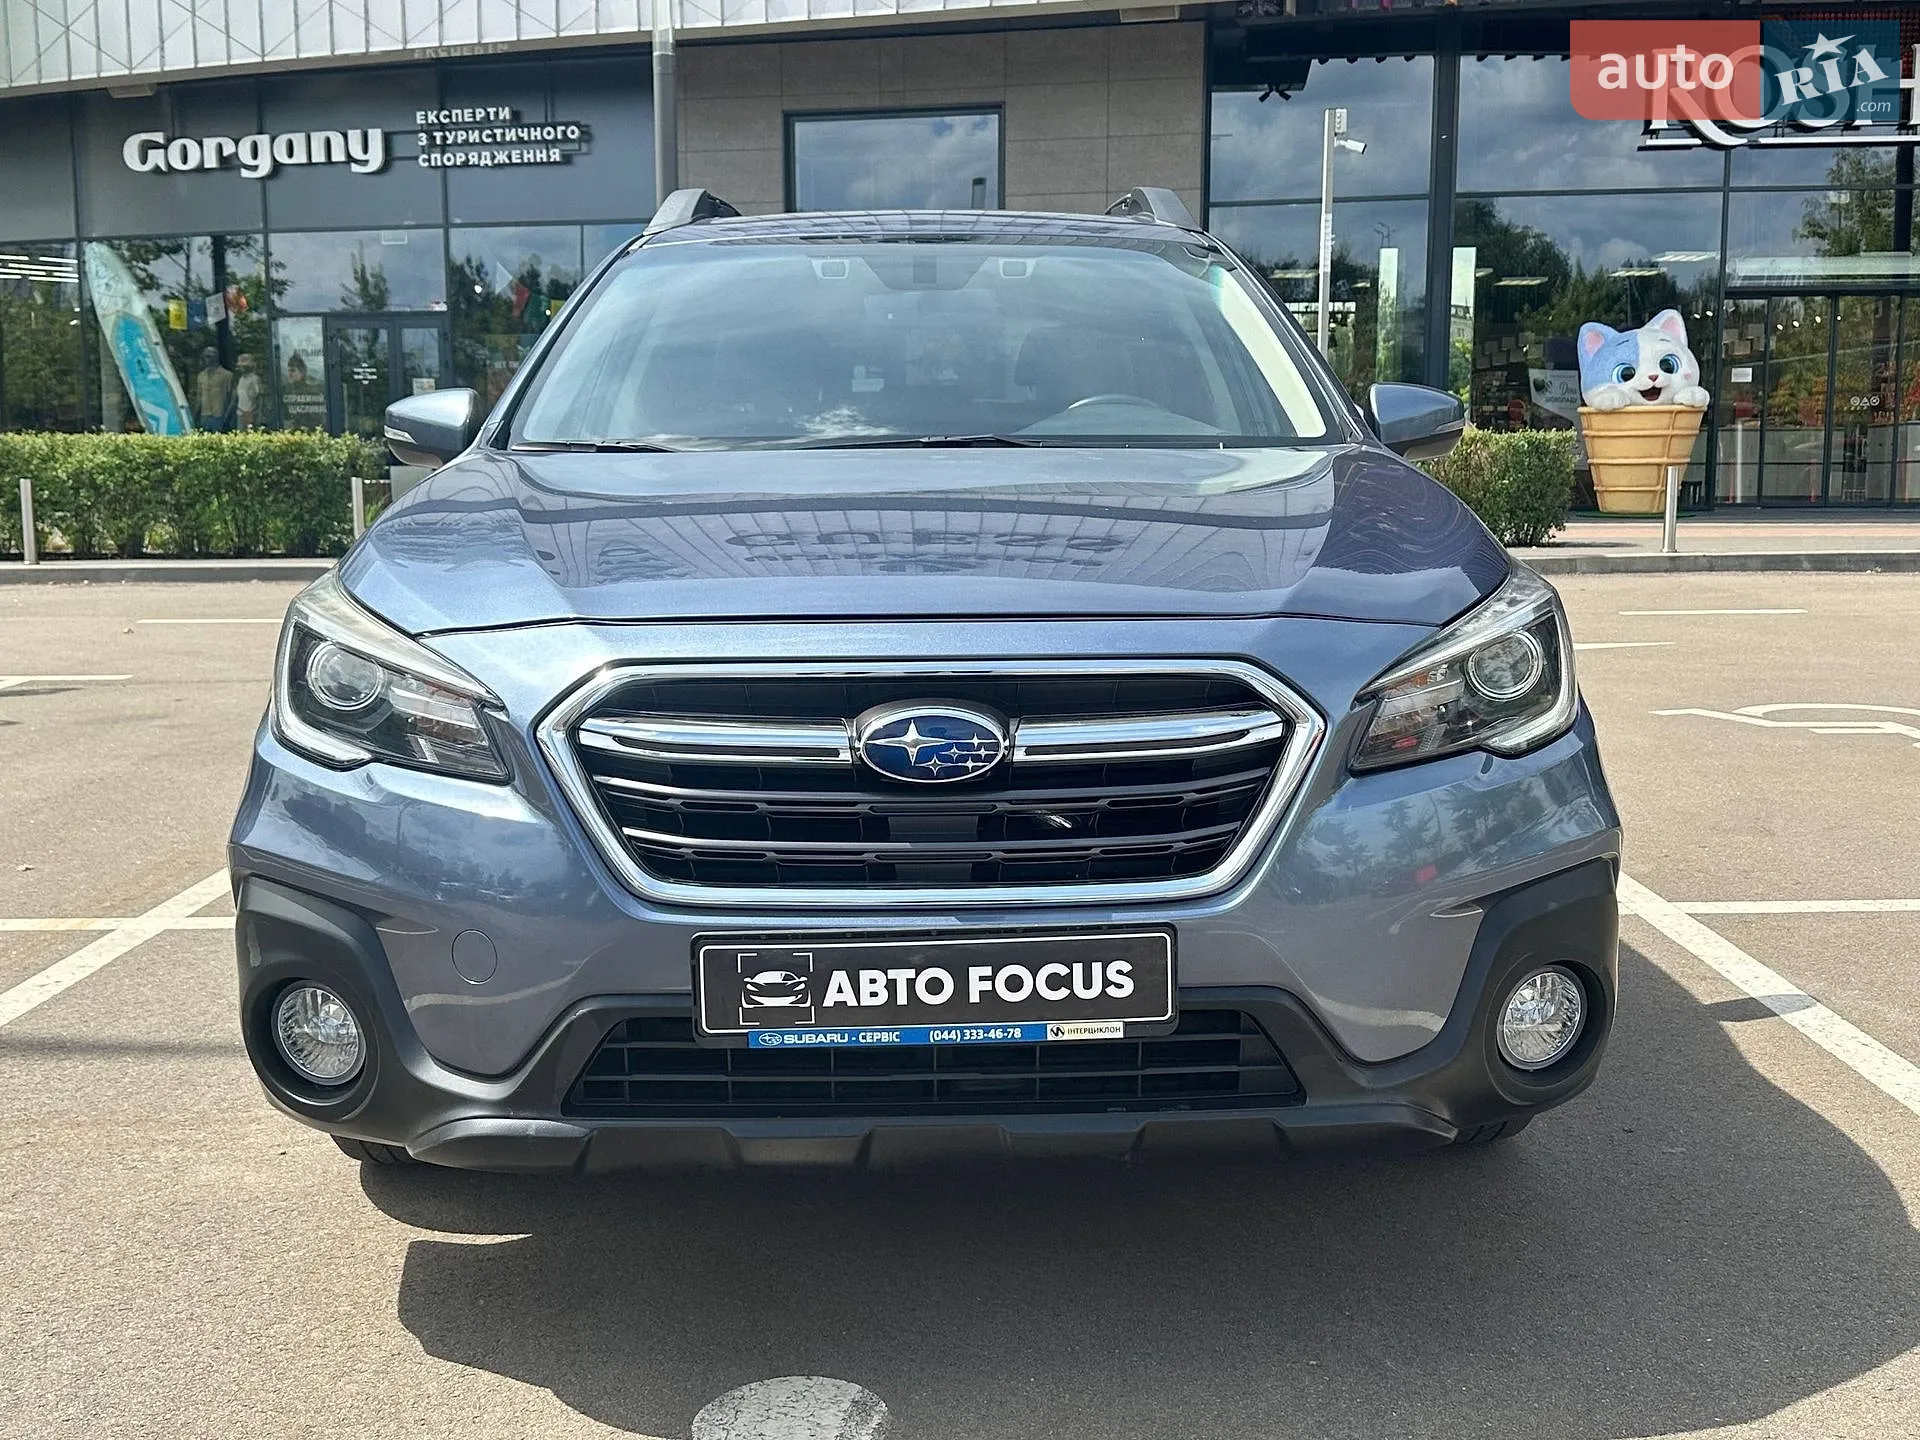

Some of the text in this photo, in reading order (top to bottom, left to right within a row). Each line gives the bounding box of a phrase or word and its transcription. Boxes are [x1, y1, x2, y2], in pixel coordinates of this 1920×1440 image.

[415, 106, 511, 125] ЕКСПЕРТИ
[433, 125, 580, 145] ТУРИСТИЧНОГО
[122, 127, 384, 179] Gorgany
[418, 148, 561, 168] СПОРЯДЖЕННЯ
[822, 960, 1135, 1007] АВТО FOCUS
[783, 1033, 849, 1044] SUBARU
[858, 1031, 900, 1043] СЕРВІС
[929, 1028, 961, 1042] (044)
[963, 1027, 1022, 1041] 333-46-78
[1067, 1025, 1121, 1036] ІНТЕРЦИКЛОН
